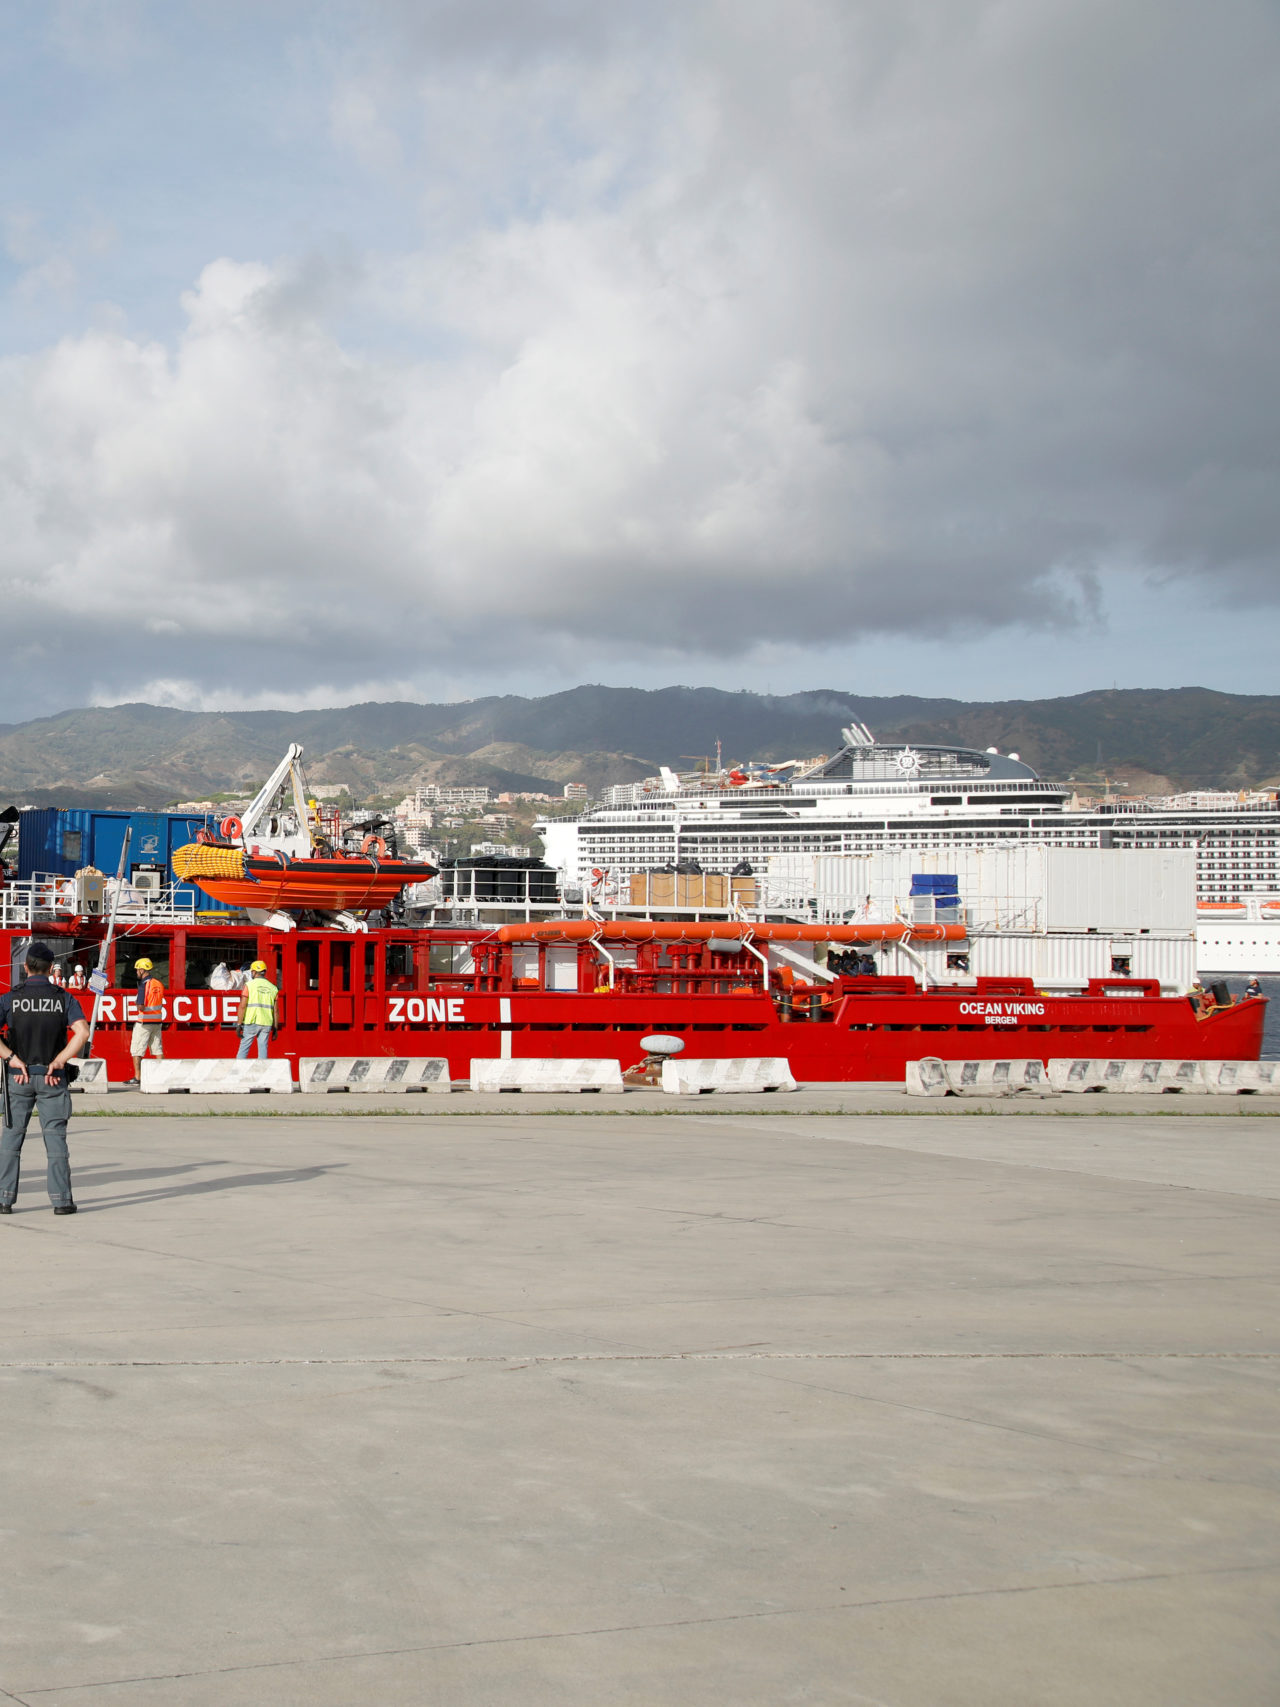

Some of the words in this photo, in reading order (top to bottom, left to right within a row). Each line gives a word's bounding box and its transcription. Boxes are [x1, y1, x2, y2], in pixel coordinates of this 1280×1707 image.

[12, 998, 63, 1013] POLIZIA
[389, 998, 465, 1022] ZONE
[960, 1002, 1002, 1014] OCEAN
[1004, 1002, 1045, 1015] VIKING
[984, 1016, 1018, 1024] BERGEN
